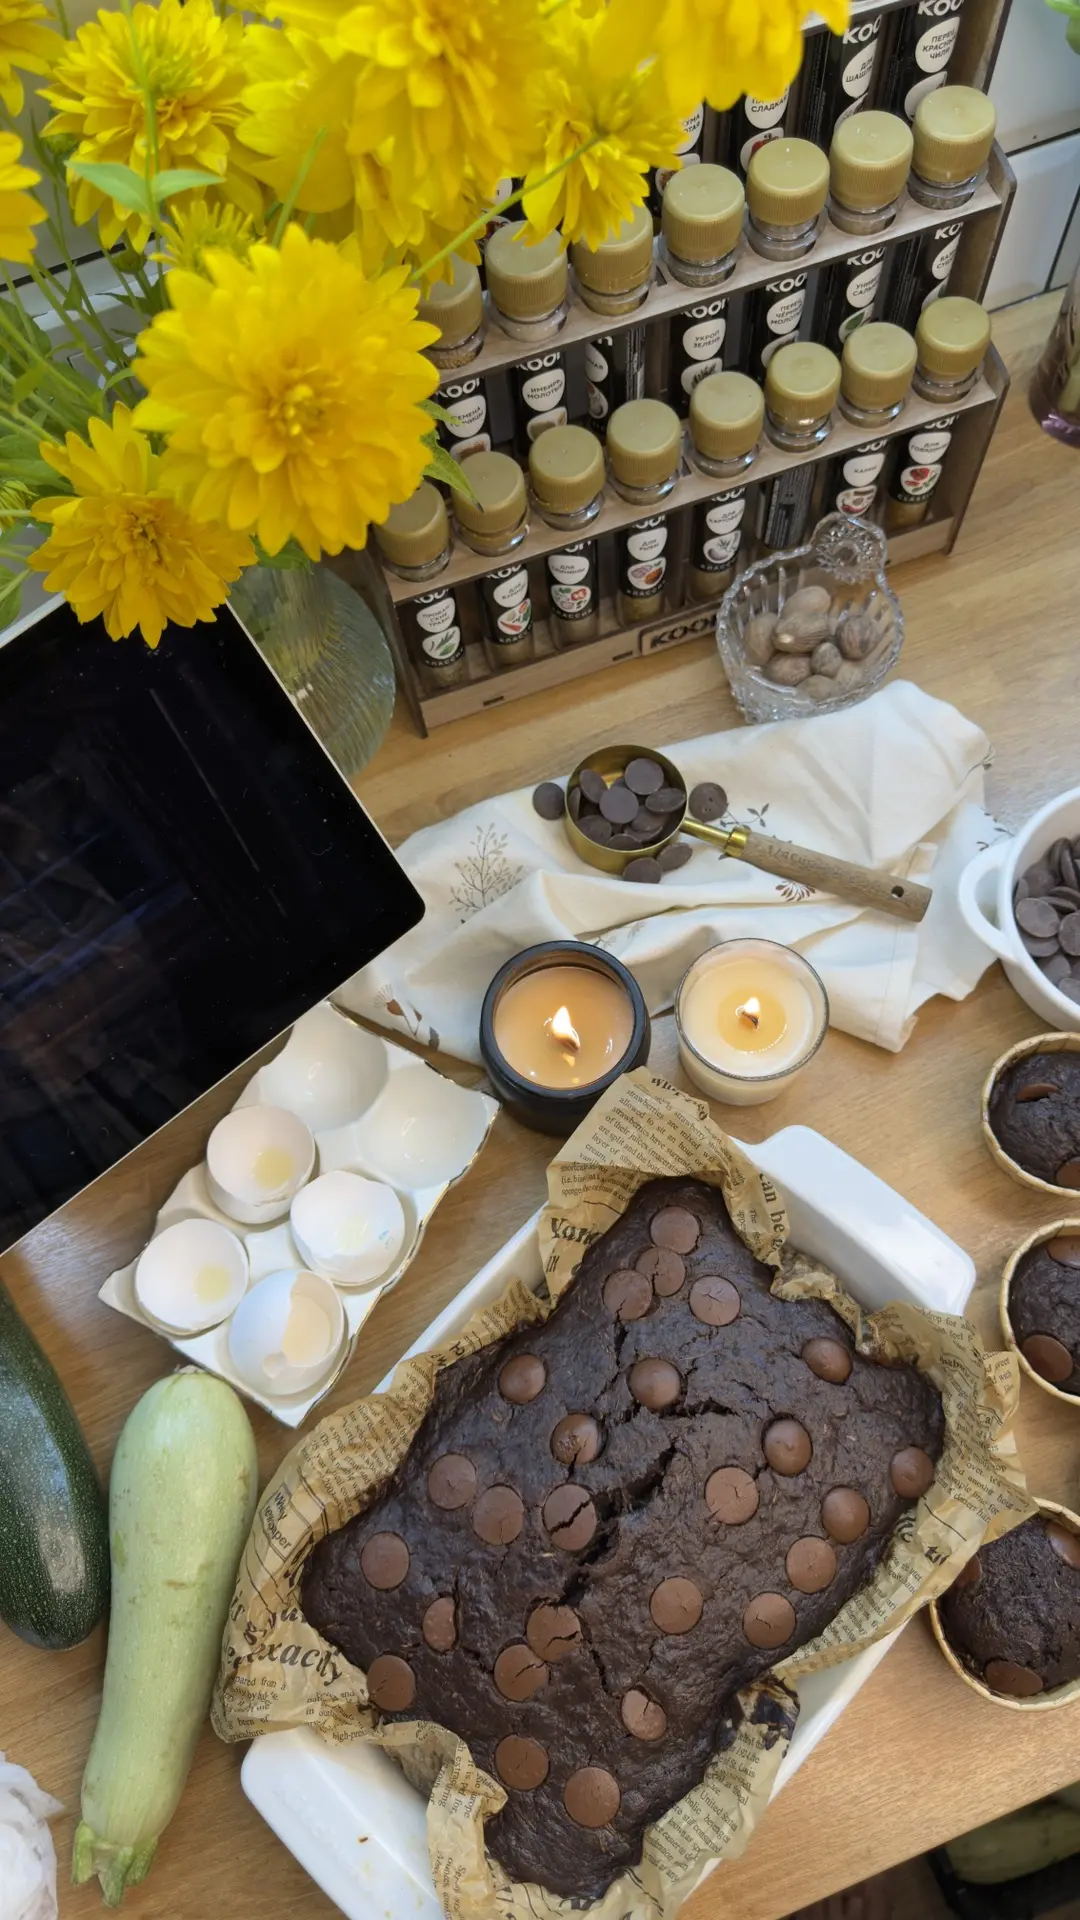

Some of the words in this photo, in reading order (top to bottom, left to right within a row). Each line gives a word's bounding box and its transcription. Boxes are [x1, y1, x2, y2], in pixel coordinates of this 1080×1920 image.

[604, 1114, 616, 1125] of
[612, 1120, 630, 1136] their
[626, 1132, 649, 1152] juices
[611, 1104, 651, 1137] strawberries
[648, 1133, 667, 1149] have
[618, 1095, 646, 1119] allowed
[645, 1117, 655, 1126] to
[655, 1124, 666, 1135] sit
[666, 1134, 676, 1143] an
[677, 1141, 695, 1158] hour
[625, 1087, 666, 1119] strawberries
[678, 1129, 701, 1150] mixed
[590, 1132, 610, 1150] layer
[608, 1145, 619, 1156] of
[597, 1124, 610, 1135] are
[607, 1131, 626, 1147] split
[623, 1142, 637, 1155] and
[635, 1151, 648, 1163] the
[768, 1206, 790, 1234] be
[996, 1493, 1014, 1510] hour
[260, 1676, 276, 1688] from
[305, 1707, 314, 1715] in
[698, 1790, 724, 1815] United
[442, 1857, 453, 1887] ounces
